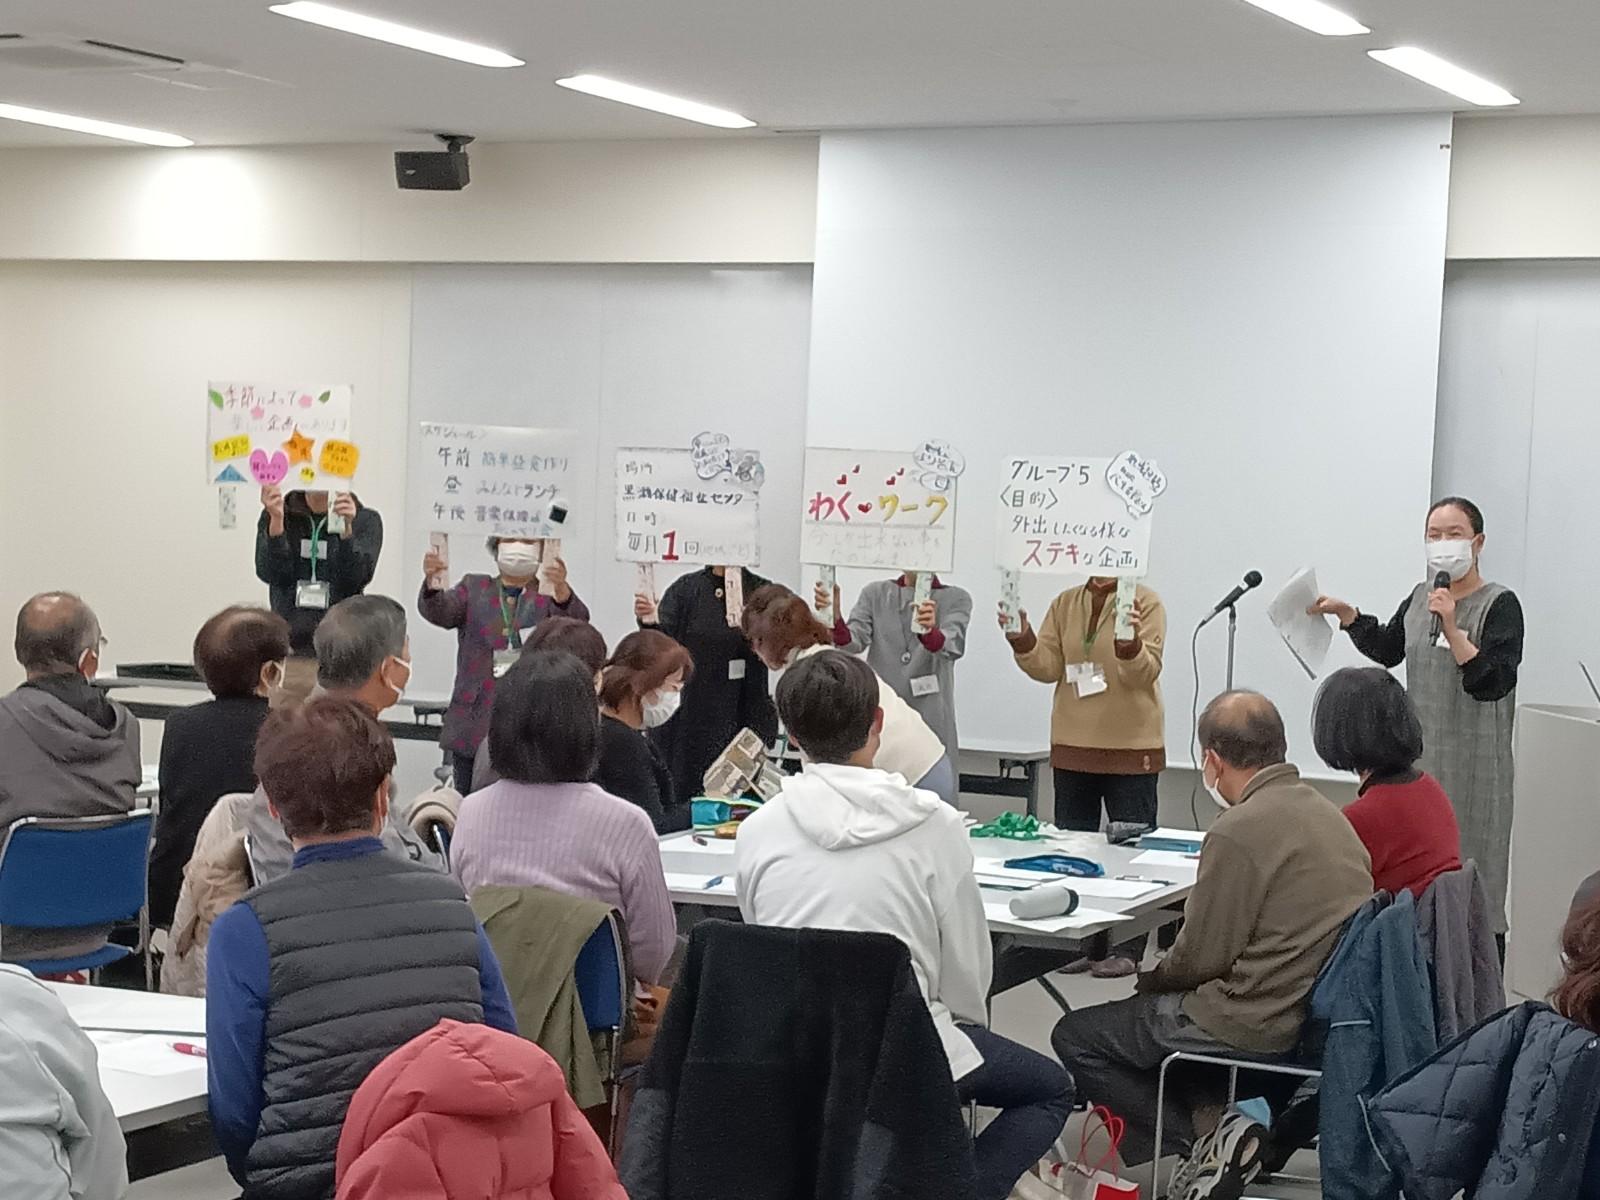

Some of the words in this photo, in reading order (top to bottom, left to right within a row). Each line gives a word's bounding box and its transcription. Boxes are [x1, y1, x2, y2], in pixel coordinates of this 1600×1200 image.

[438, 446, 470, 467] 午前
[433, 502, 465, 520] 午後
[808, 491, 851, 522] わく
[1012, 515, 1130, 538] 外出したくなる様な
[1022, 540, 1138, 568] ステキな企画
